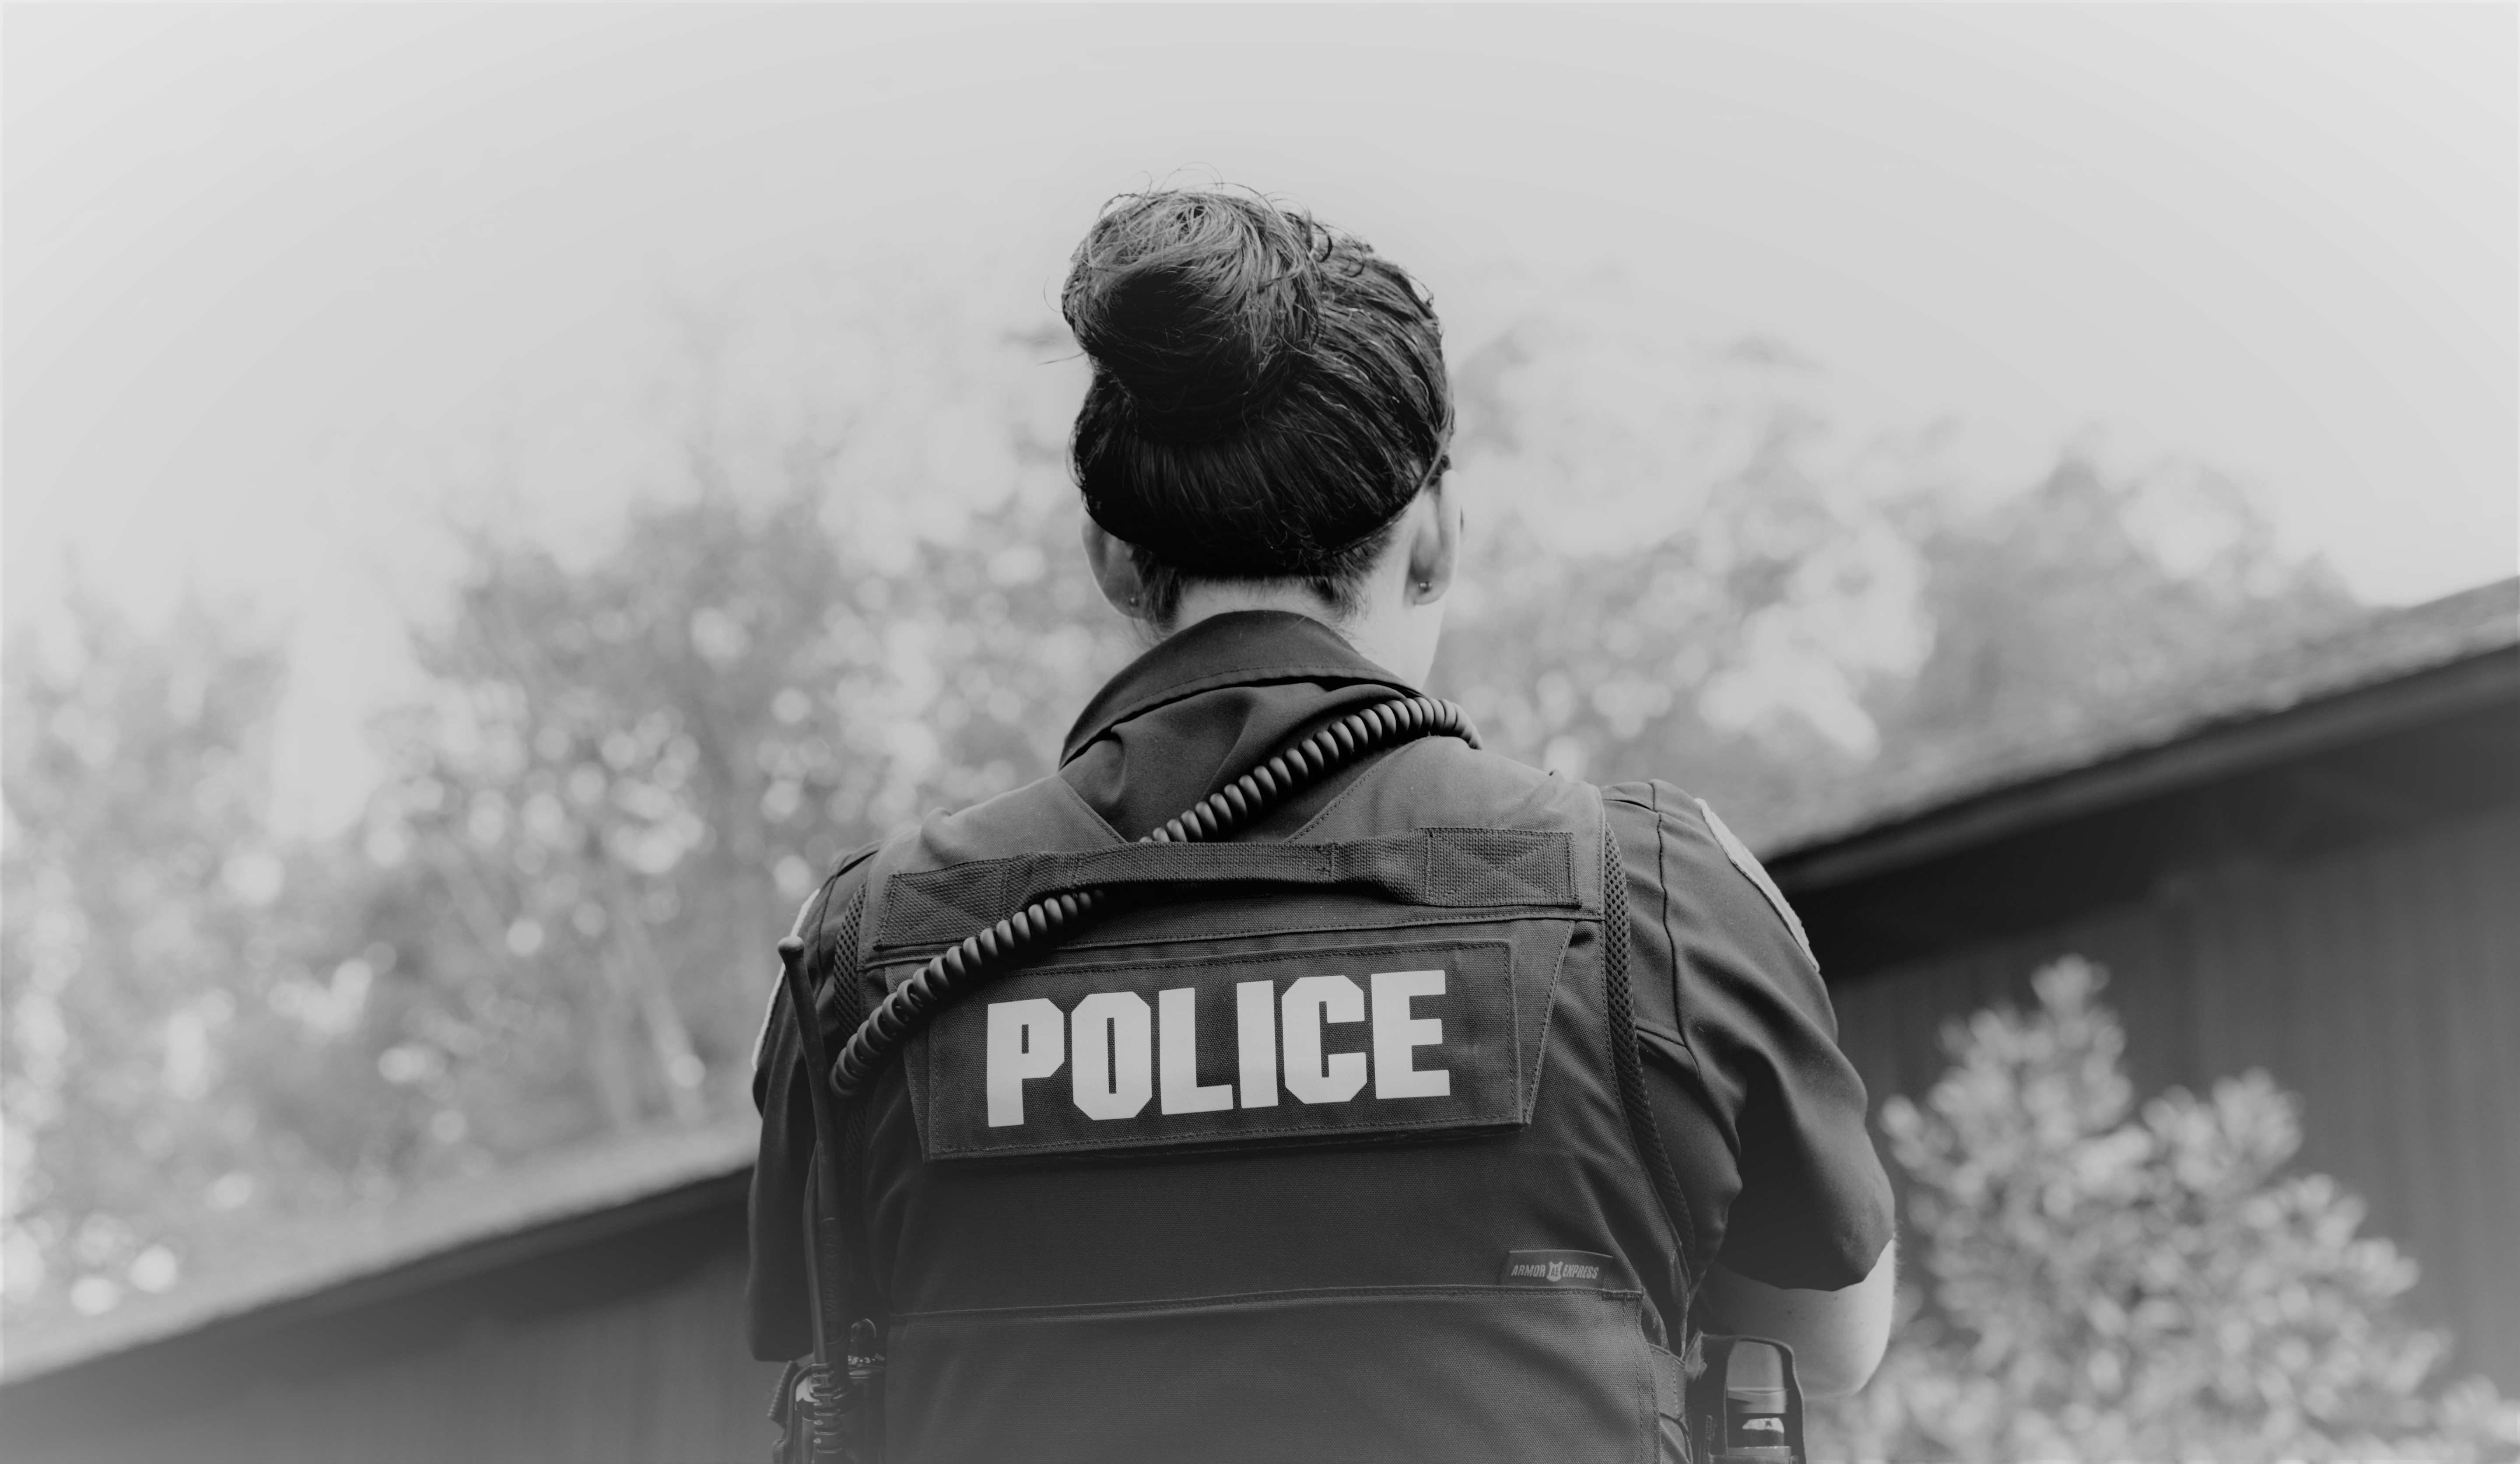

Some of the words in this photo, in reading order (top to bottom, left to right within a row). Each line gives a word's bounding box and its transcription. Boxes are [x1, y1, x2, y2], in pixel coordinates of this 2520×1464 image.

[987, 970, 1450, 1127] POLICE
[825, 1228, 838, 1257] GPS
[1511, 1264, 1546, 1277] ARMOR
[1562, 1264, 1599, 1279] EXPRESS
